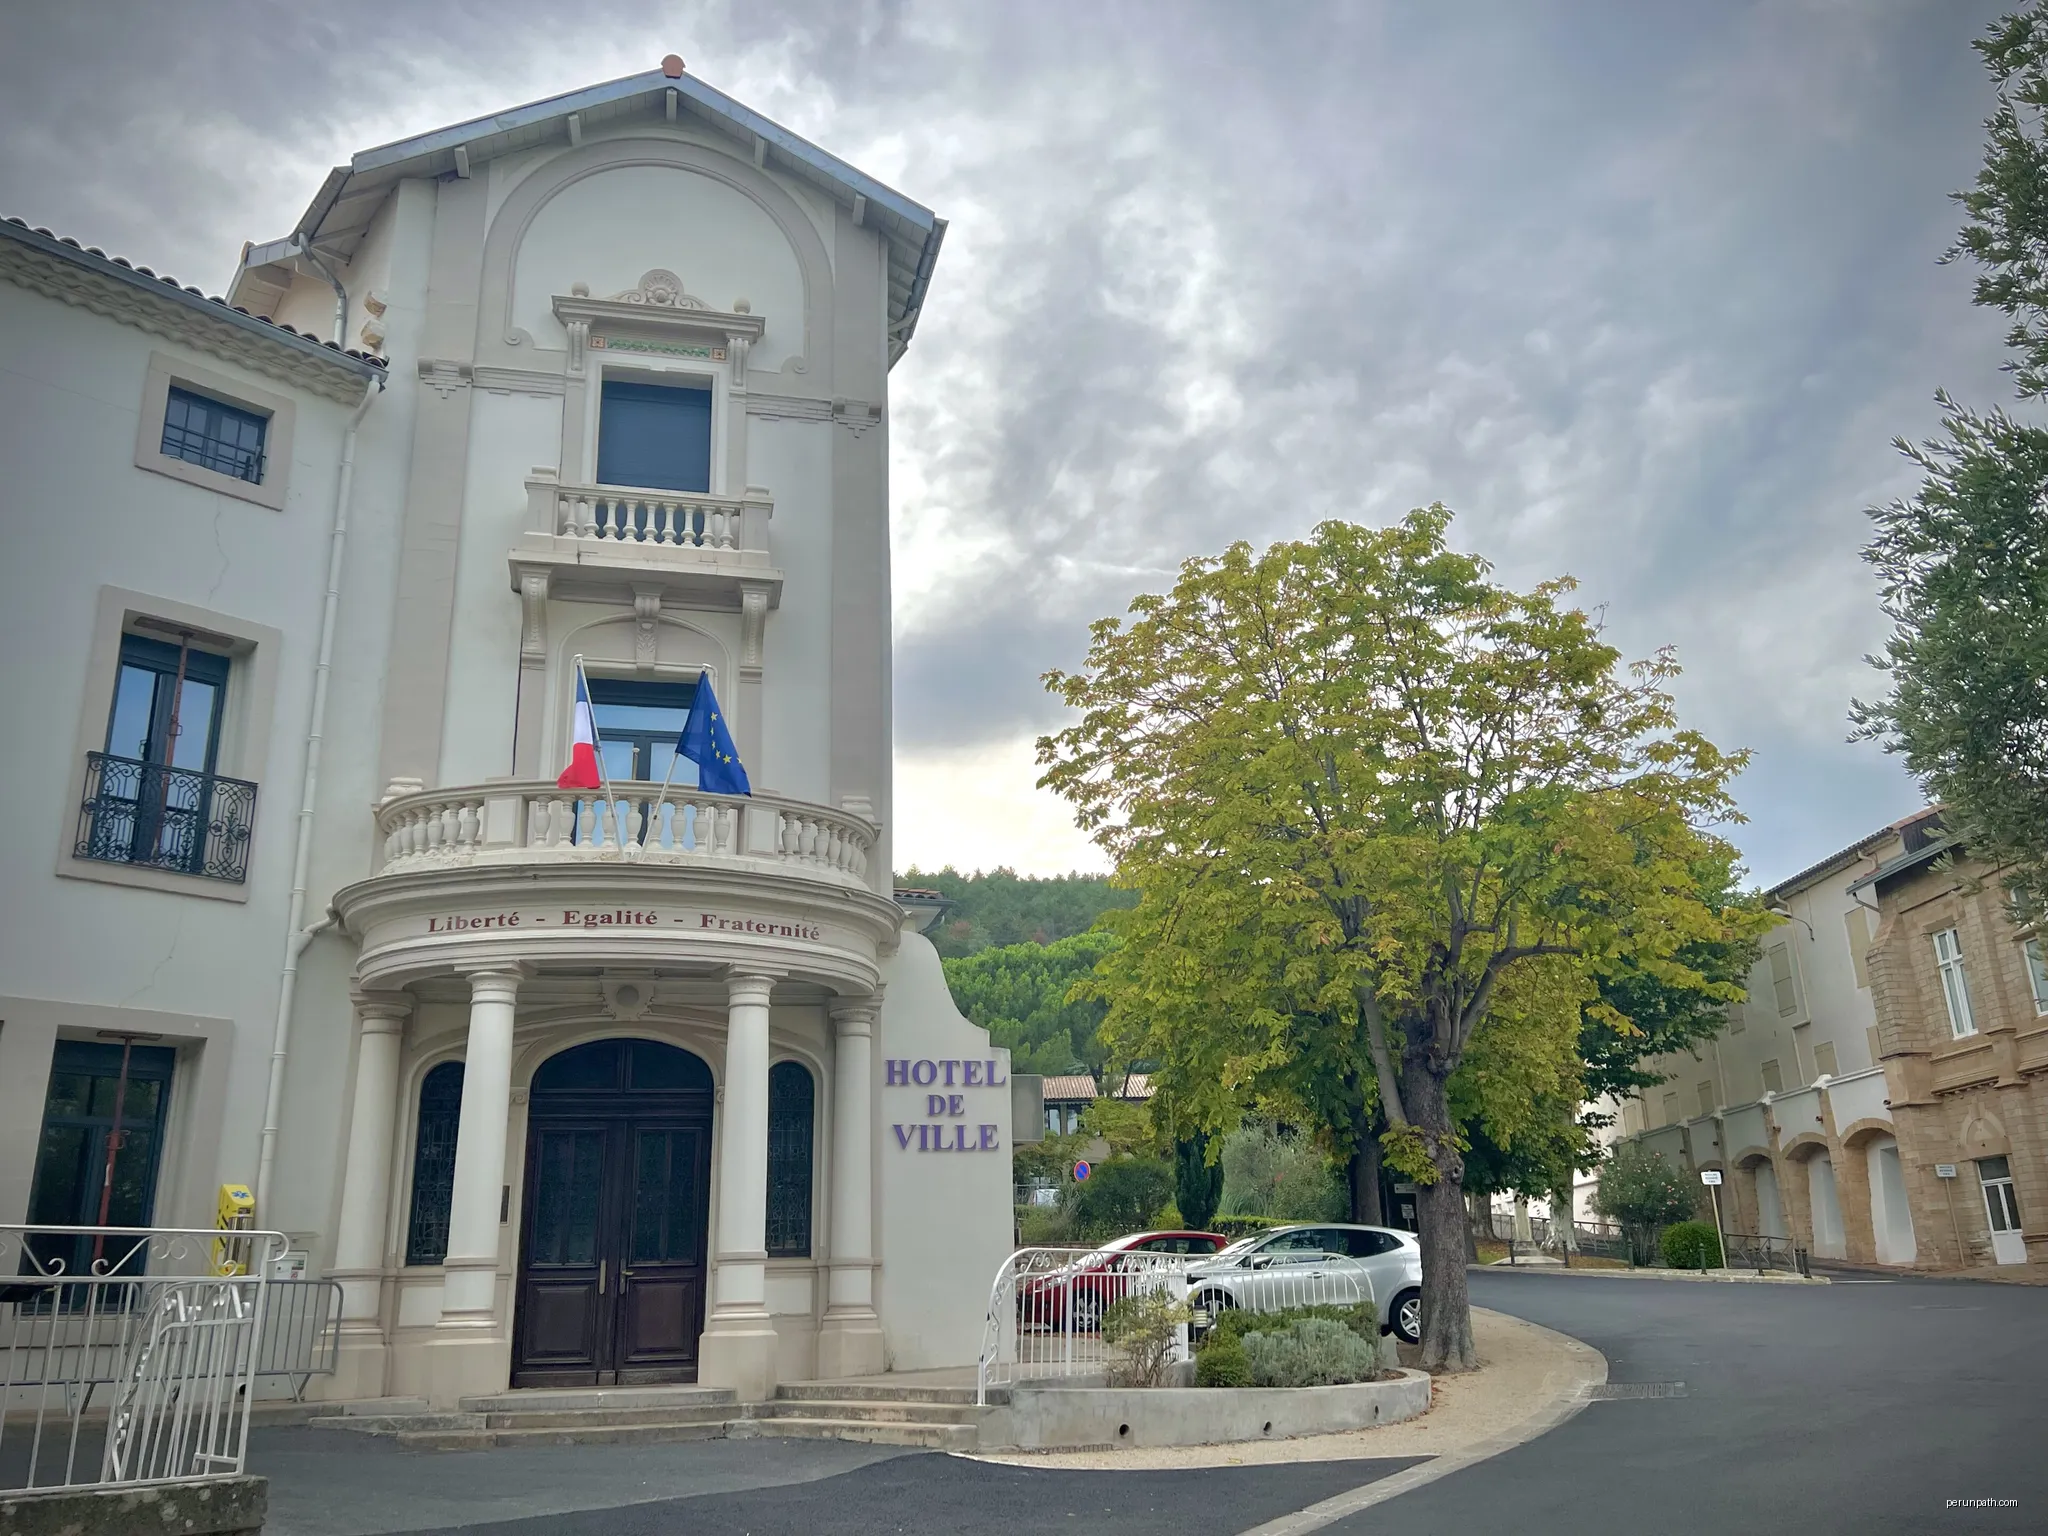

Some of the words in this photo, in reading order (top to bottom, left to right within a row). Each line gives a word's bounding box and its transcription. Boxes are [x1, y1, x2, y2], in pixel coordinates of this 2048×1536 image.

[428, 912, 520, 932] Liberté
[562, 910, 658, 928] Egalité
[700, 913, 820, 940] Fraternité
[885, 1060, 1006, 1086] HOTEL
[927, 1095, 965, 1117] DE
[892, 1124, 999, 1152] VILLE
